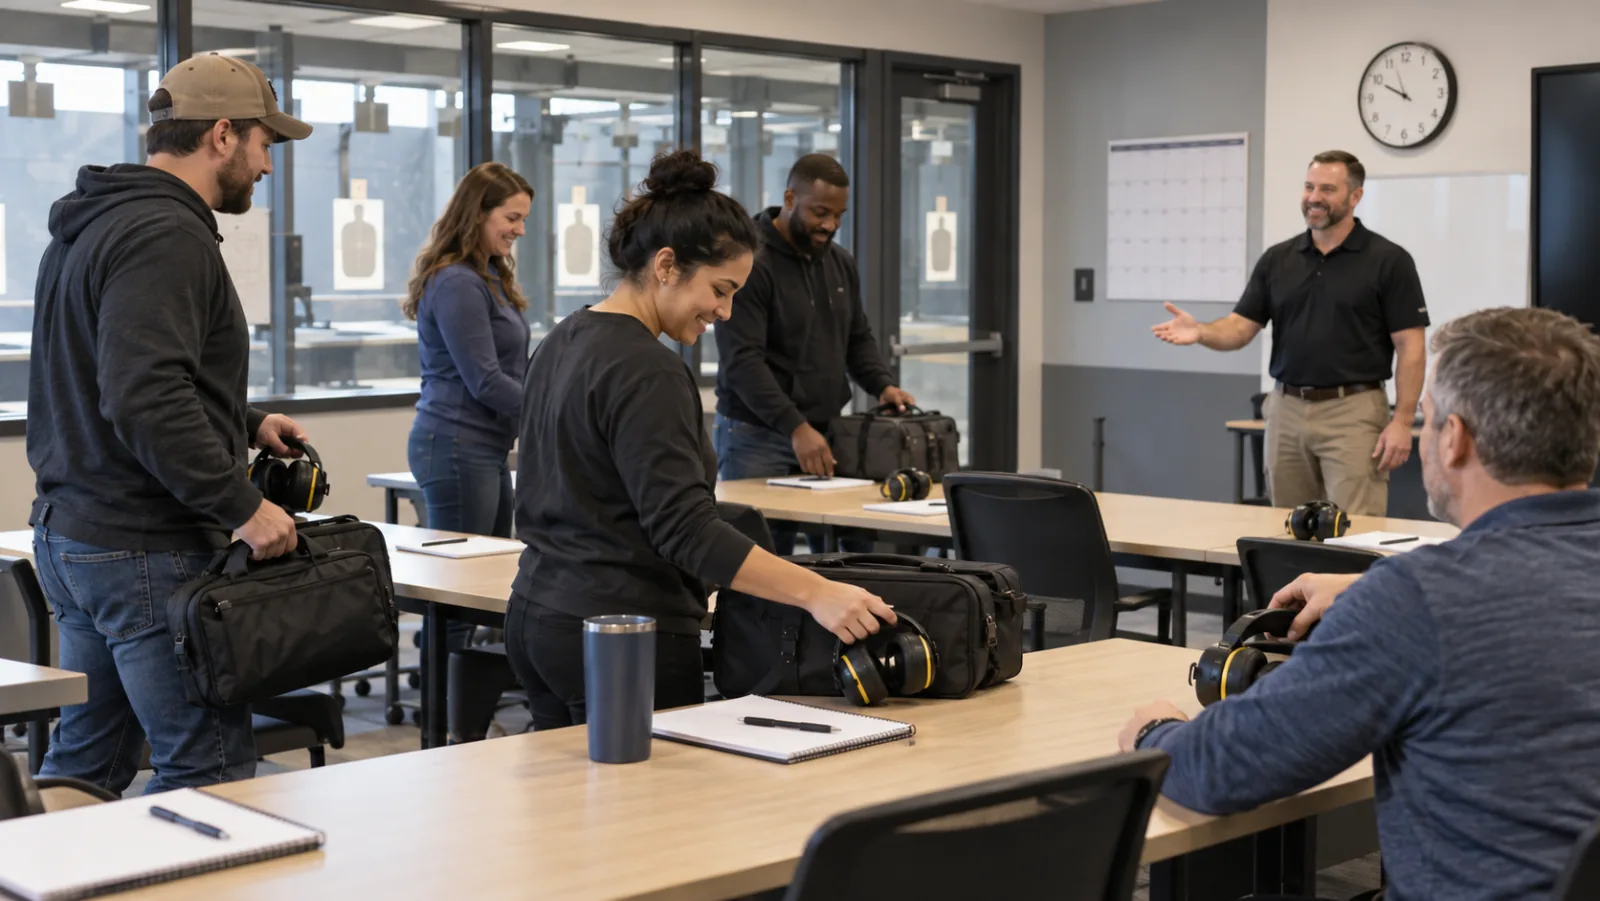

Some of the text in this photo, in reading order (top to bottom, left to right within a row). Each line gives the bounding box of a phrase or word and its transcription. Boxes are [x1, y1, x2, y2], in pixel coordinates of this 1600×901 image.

[1400, 52, 1412, 63] 12
[1385, 59, 1394, 69] 11
[1432, 68, 1440, 79] 2
[1373, 74, 1383, 85] 10
[1437, 88, 1444, 98] 3
[1368, 94, 1374, 103] 9
[1372, 112, 1379, 122] 8
[1431, 108, 1438, 118] 4
[1385, 124, 1391, 134] 7
[1418, 123, 1425, 133] 5
[1401, 129, 1408, 139] 6
